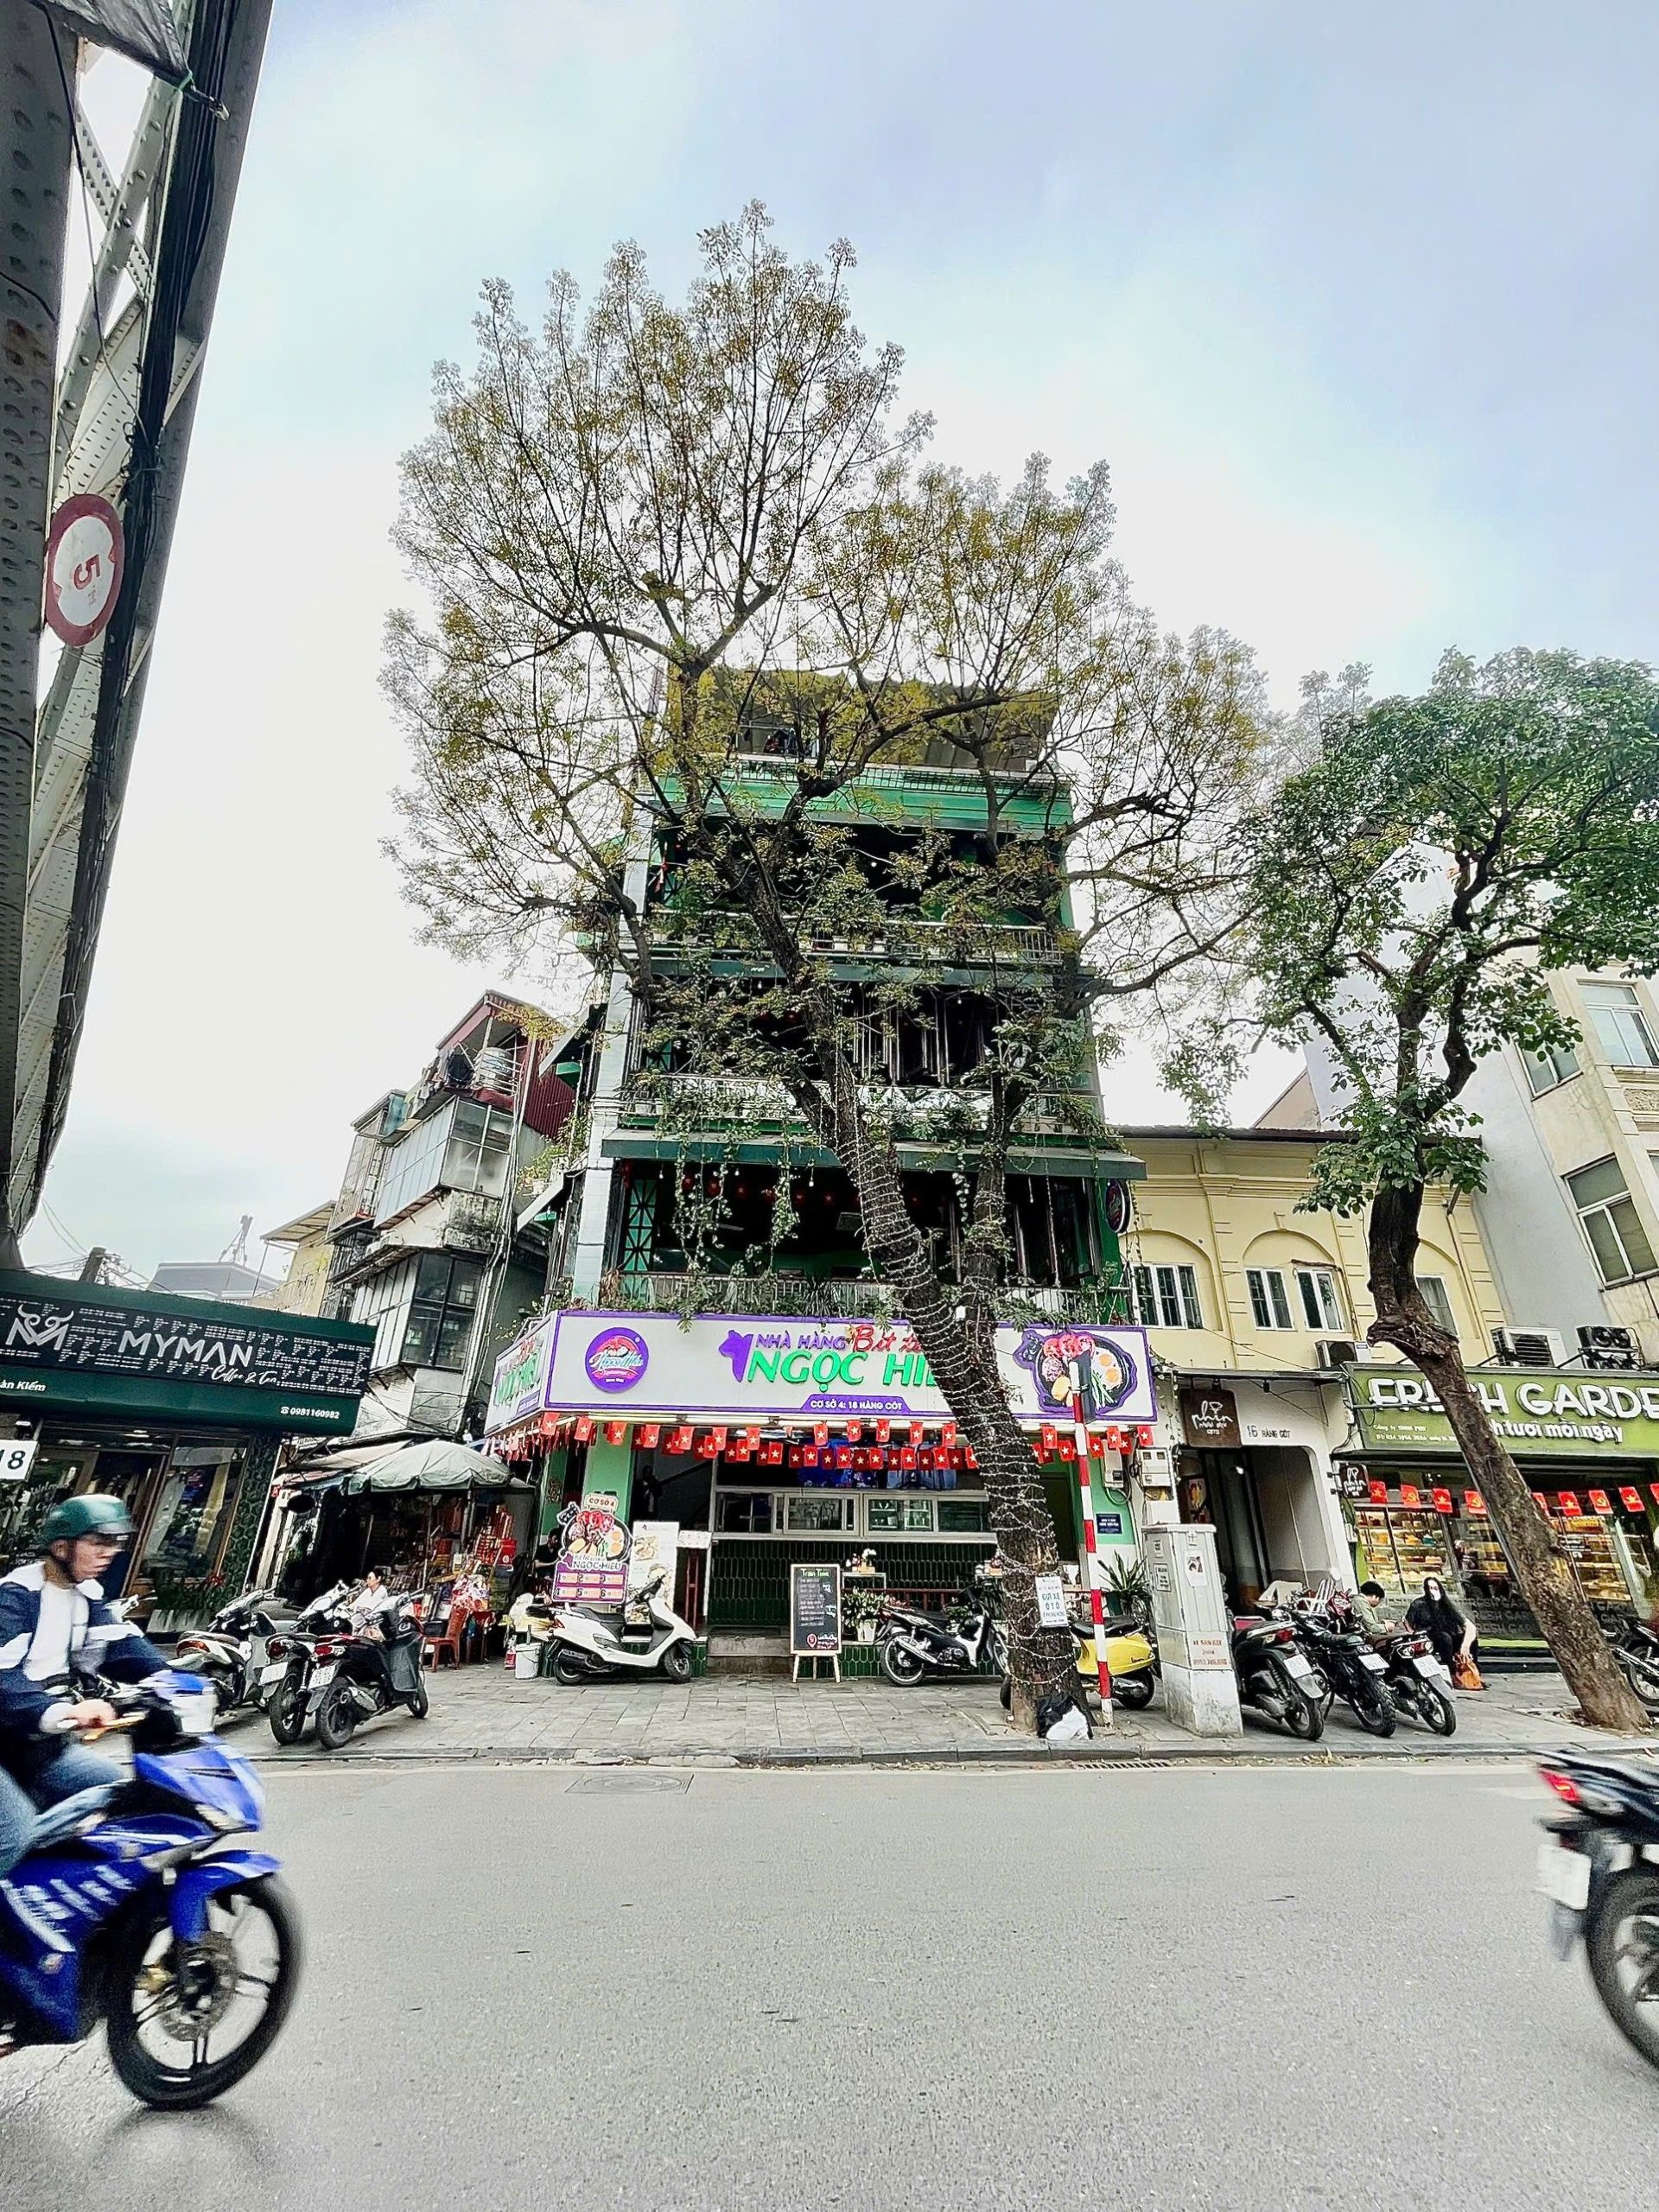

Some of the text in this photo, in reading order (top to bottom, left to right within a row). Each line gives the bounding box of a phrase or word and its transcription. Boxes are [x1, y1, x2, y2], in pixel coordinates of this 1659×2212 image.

[118, 1330, 253, 1367] MYMAN
[755, 1330, 791, 1349] NHÀ
[798, 1331, 846, 1350] HÀNG
[211, 1364, 277, 1384] Coffee & Tea
[747, 1350, 938, 1392] NGỌC HI
[16, 1381, 46, 1392] Kiếm
[810, 1400, 823, 1408] CƠ
[825, 1398, 837, 1408] SỞ
[838, 1401, 846, 1409] 4:
[859, 1400, 883, 1410] HÀNG
[885, 1400, 902, 1410] CÓT
[1247, 1425, 1258, 1438] 16
[1581, 1421, 1623, 1444] ngày
